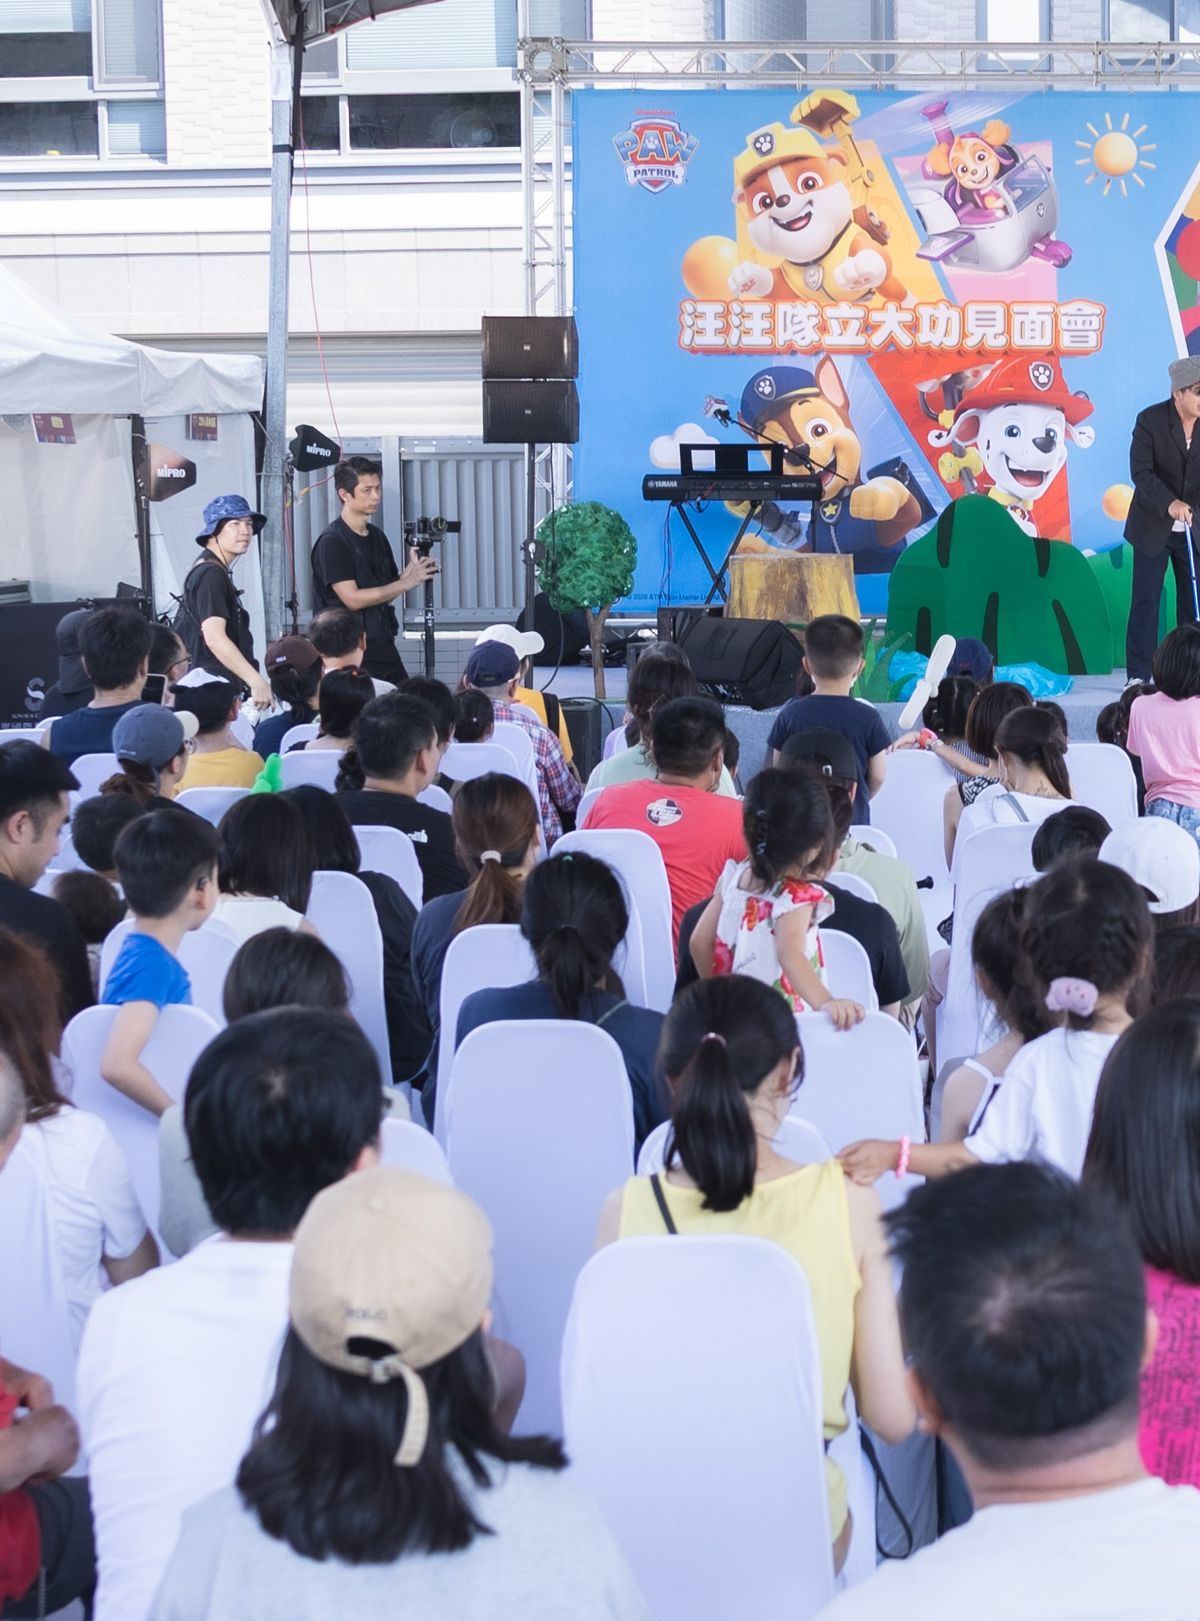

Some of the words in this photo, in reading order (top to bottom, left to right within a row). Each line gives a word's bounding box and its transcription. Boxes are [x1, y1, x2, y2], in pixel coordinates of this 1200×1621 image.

[612, 130, 700, 163] PAW
[633, 167, 679, 179] PATROL
[681, 299, 1103, 349] 汪汪隊立大功見面會
[655, 480, 678, 488] YAMAHA
